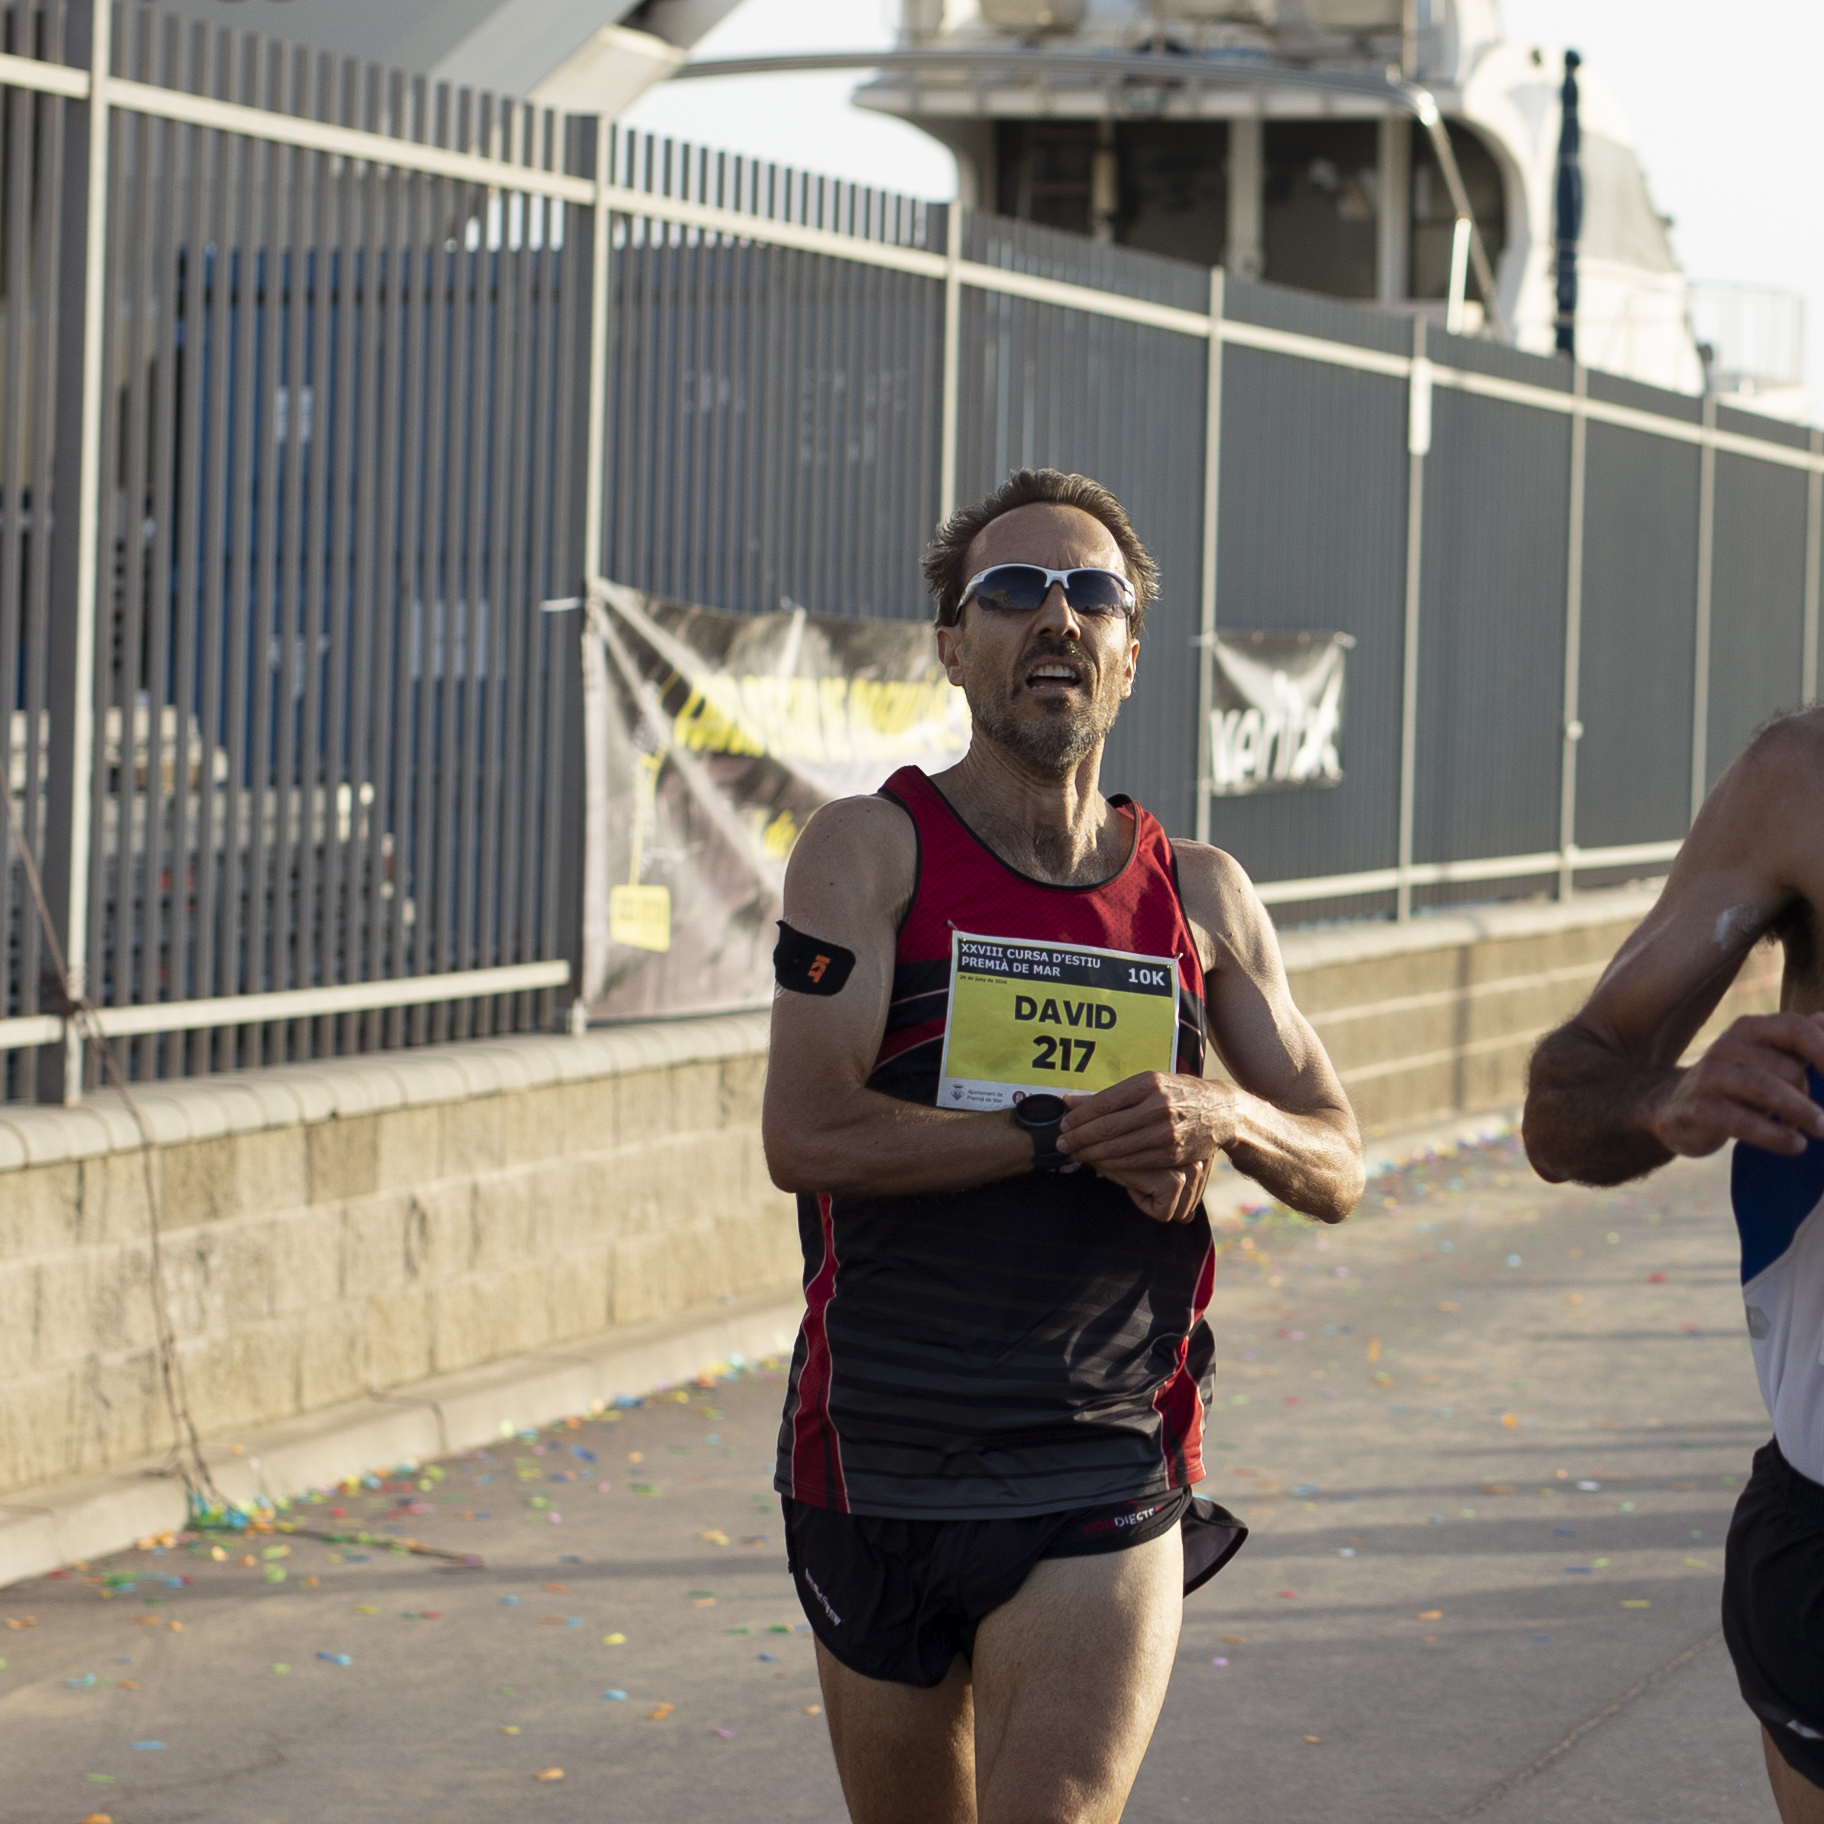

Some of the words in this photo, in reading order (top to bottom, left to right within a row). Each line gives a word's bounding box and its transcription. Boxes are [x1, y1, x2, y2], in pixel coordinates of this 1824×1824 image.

[961, 942, 1003, 958] XXVIII
[1007, 949, 1049, 963] CURSA
[961, 956, 1009, 973] PREMIÀ
[1013, 962, 1030, 974] DE
[1033, 964, 1061, 977] MAR
[1128, 968, 1166, 987] 10K
[1014, 995, 1118, 1030] DAVID
[1032, 1035, 1097, 1073] 217
